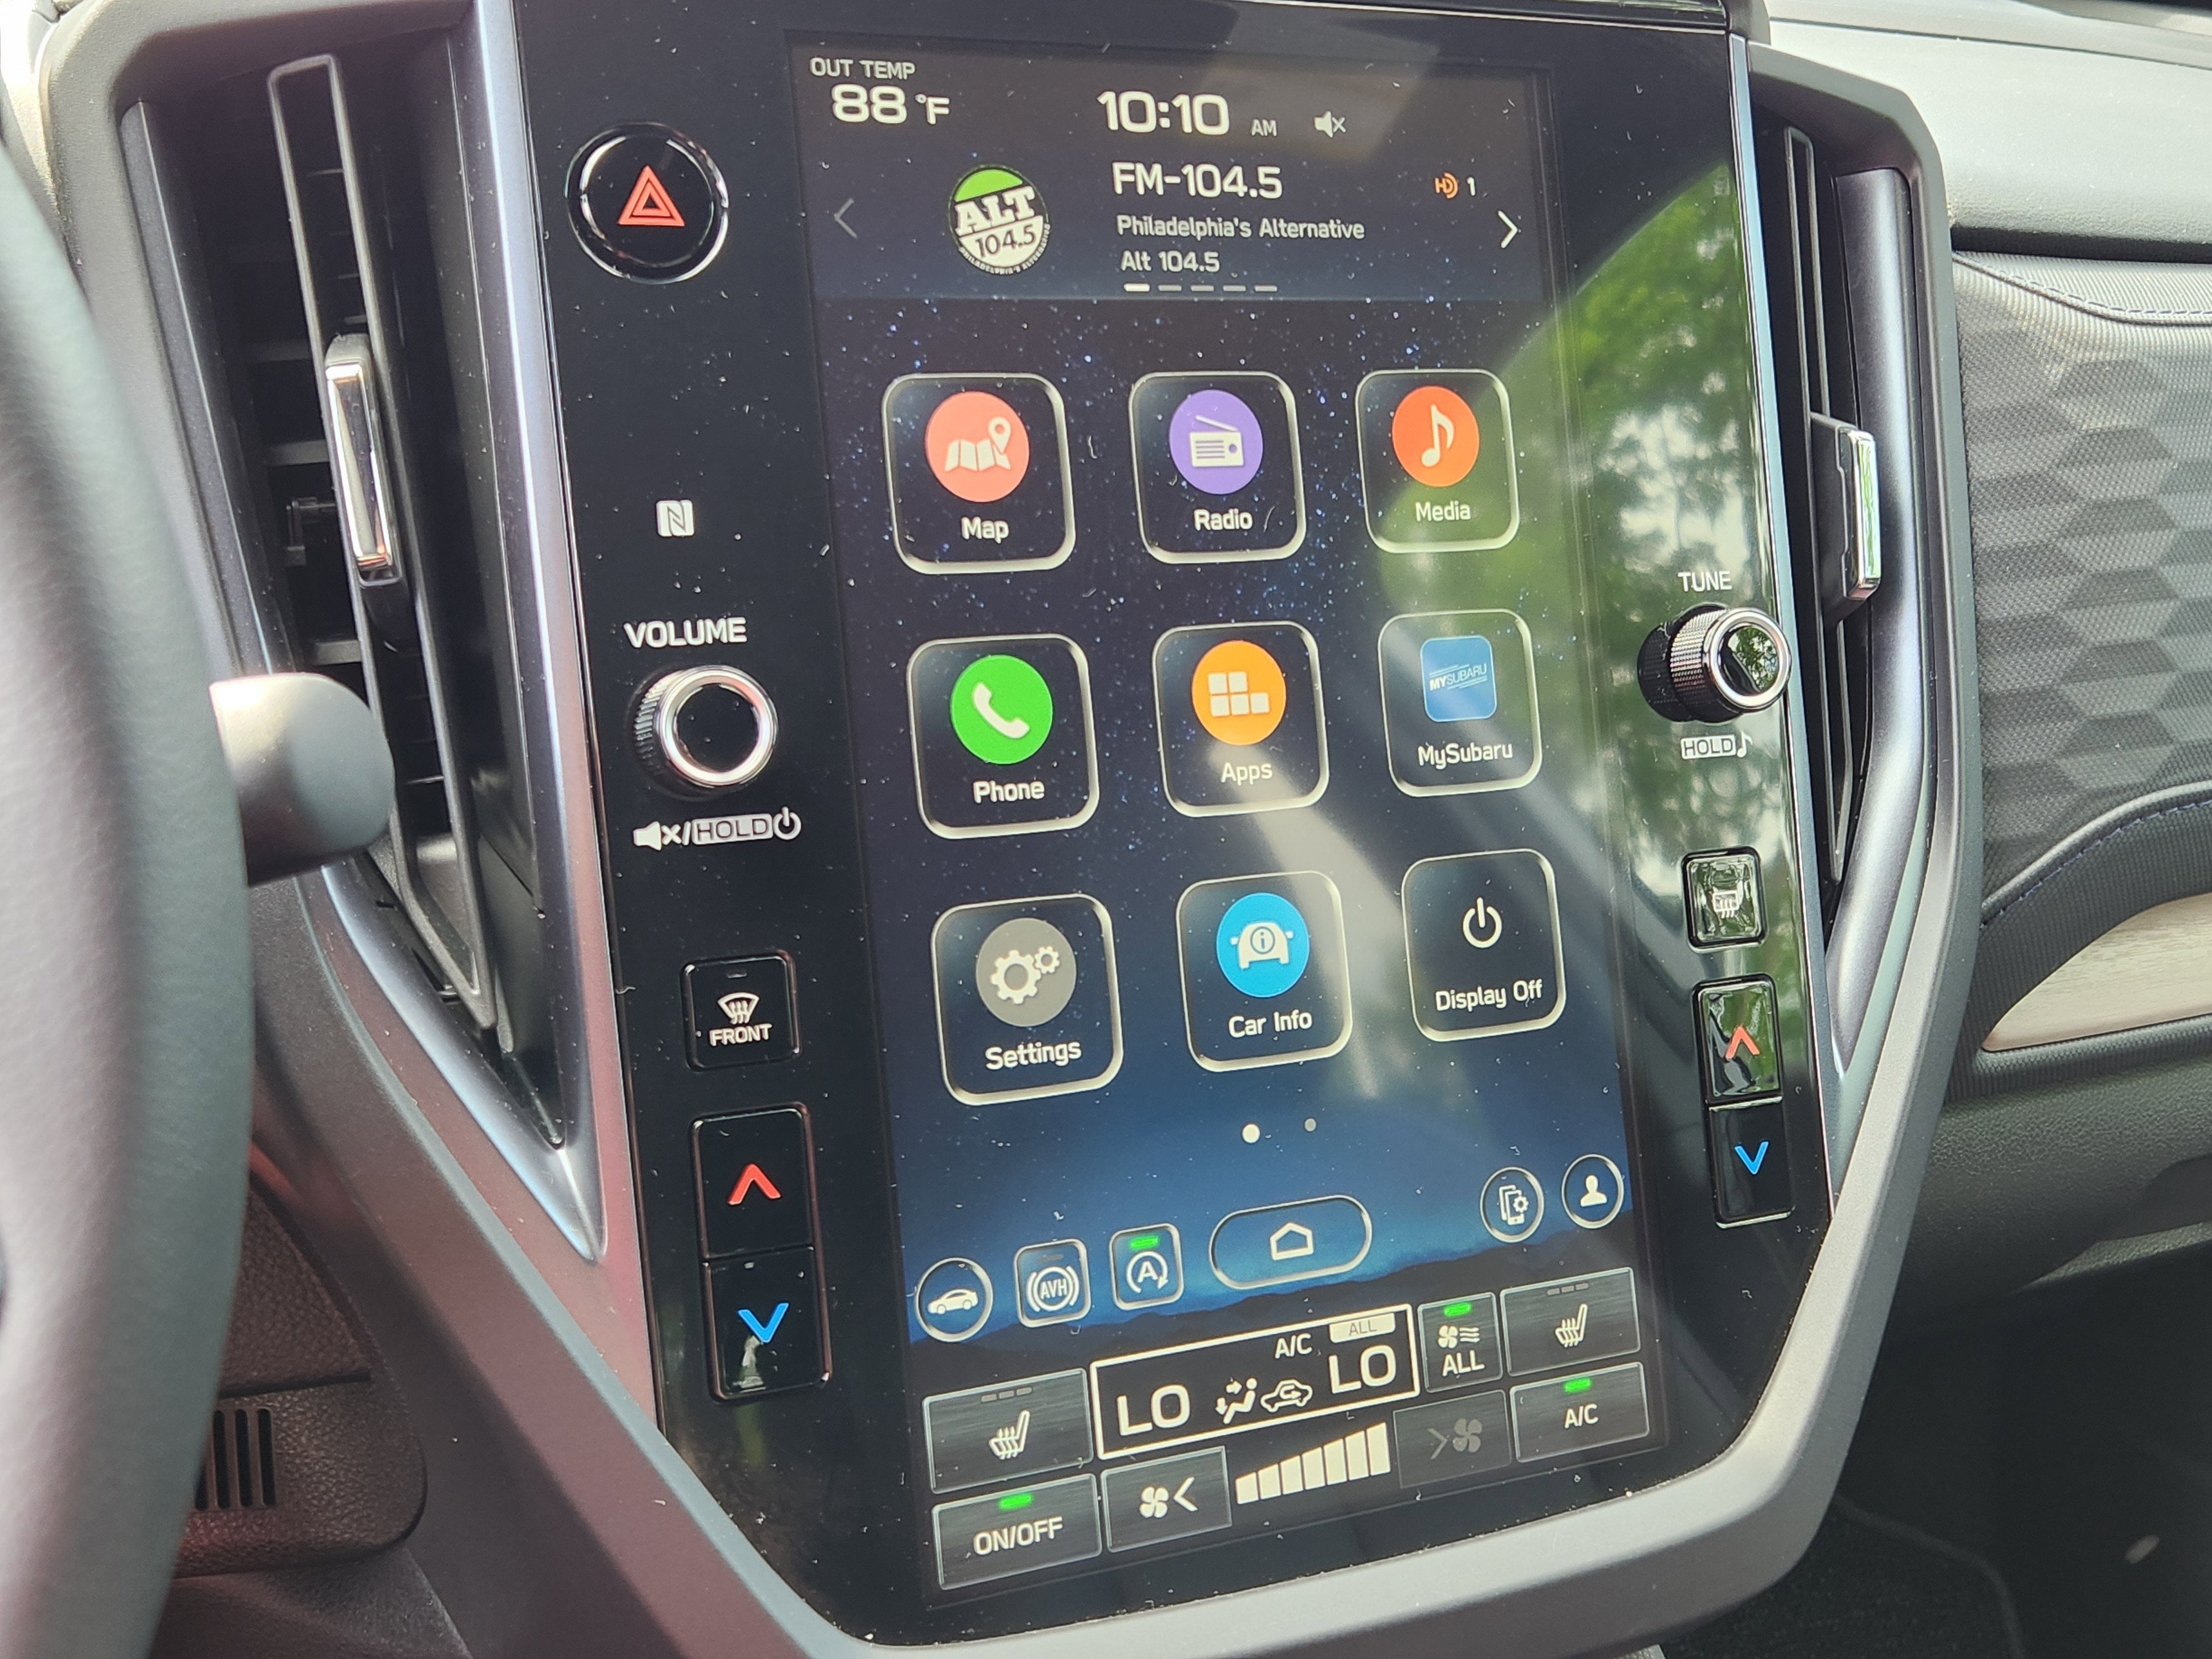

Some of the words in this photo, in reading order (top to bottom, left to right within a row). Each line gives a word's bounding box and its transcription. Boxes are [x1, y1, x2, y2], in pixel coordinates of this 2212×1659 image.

[810, 57, 853, 77] OUT
[859, 59, 915, 80] TEMP
[832, 84, 907, 124] 88
[1097, 91, 1229, 135] 10:10
[1251, 119, 1277, 137] AM
[1112, 161, 1282, 199] FM-104.5
[1467, 176, 1476, 196] 1
[954, 186, 1035, 237] ALT
[1117, 215, 1251, 240] Philadelphia's
[1259, 219, 1364, 239] Alternative
[975, 224, 1035, 258] 104.5
[1121, 251, 1151, 272] Alt
[1158, 252, 1220, 273] 104.5
[1193, 509, 1253, 530] Radio
[1416, 500, 1470, 522] Media
[962, 517, 1009, 542] Map
[1678, 570, 1732, 592] TUNE
[624, 618, 747, 648] VOLUME
[1418, 742, 1512, 770] MySubaru
[1683, 738, 1733, 757] HOLD
[1220, 763, 1272, 784] Apps
[973, 779, 1044, 803] Phone
[1436, 985, 1507, 1012] Display
[1513, 978, 1542, 1001] Off
[709, 1024, 773, 1046] FRONT
[1228, 1014, 1265, 1038] Car
[1274, 1009, 1312, 1032] Info
[985, 1039, 1082, 1070] Settings
[1040, 1282, 1067, 1300] AVH
[1348, 1318, 1378, 1336] ALL
[1275, 1333, 1312, 1359] A/C
[1329, 1345, 1396, 1394] LO
[1442, 1350, 1485, 1376] ALL
[1117, 1385, 1191, 1436] LO
[1564, 1404, 1599, 1428] A/C
[973, 1517, 1063, 1556] ON/OFF
